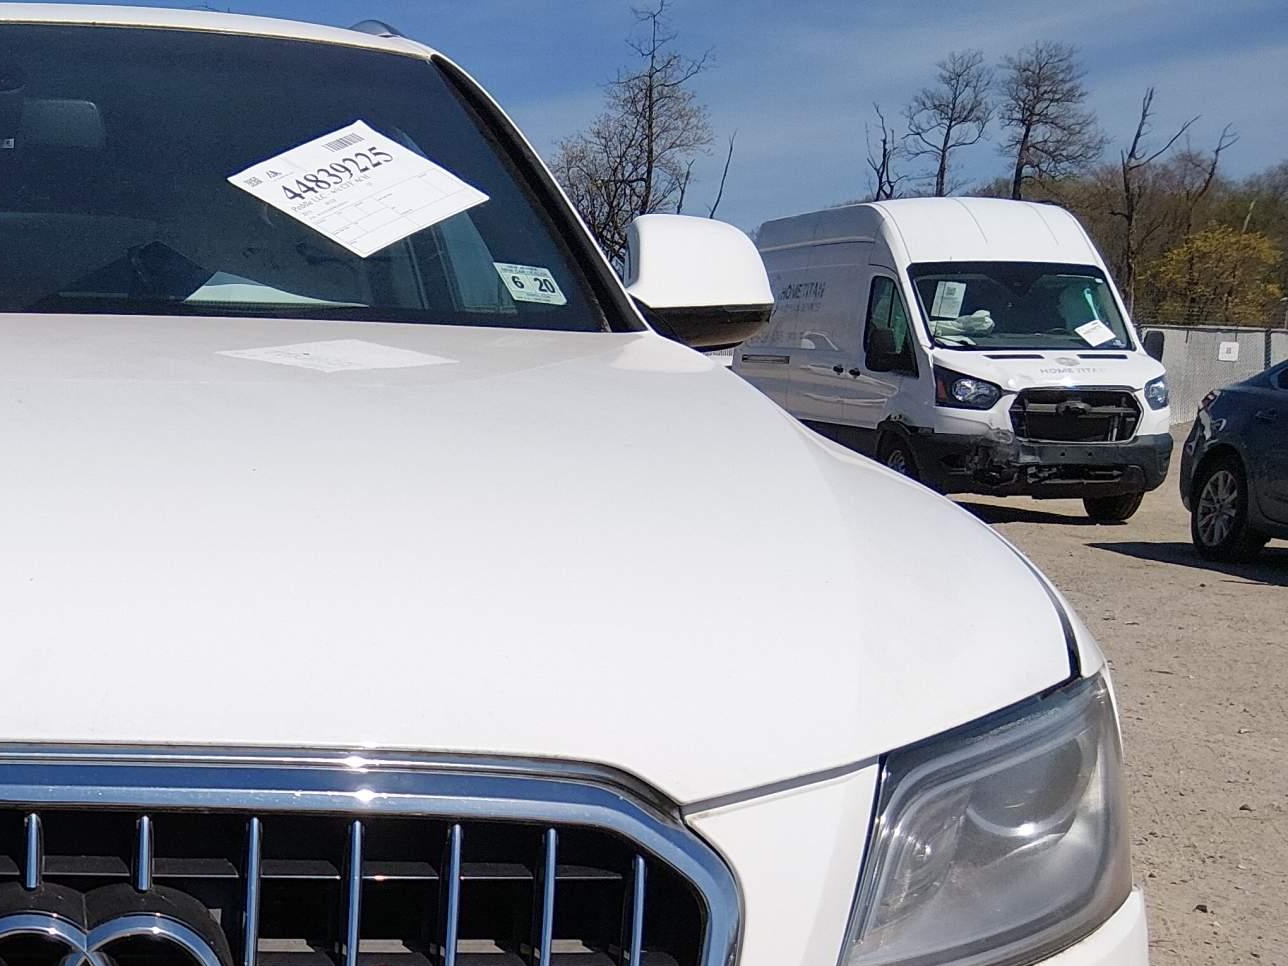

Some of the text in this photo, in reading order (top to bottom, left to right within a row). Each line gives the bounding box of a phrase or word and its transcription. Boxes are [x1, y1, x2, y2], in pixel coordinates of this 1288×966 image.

[281, 146, 394, 202] 44839225
[511, 275, 556, 294] 6 20
